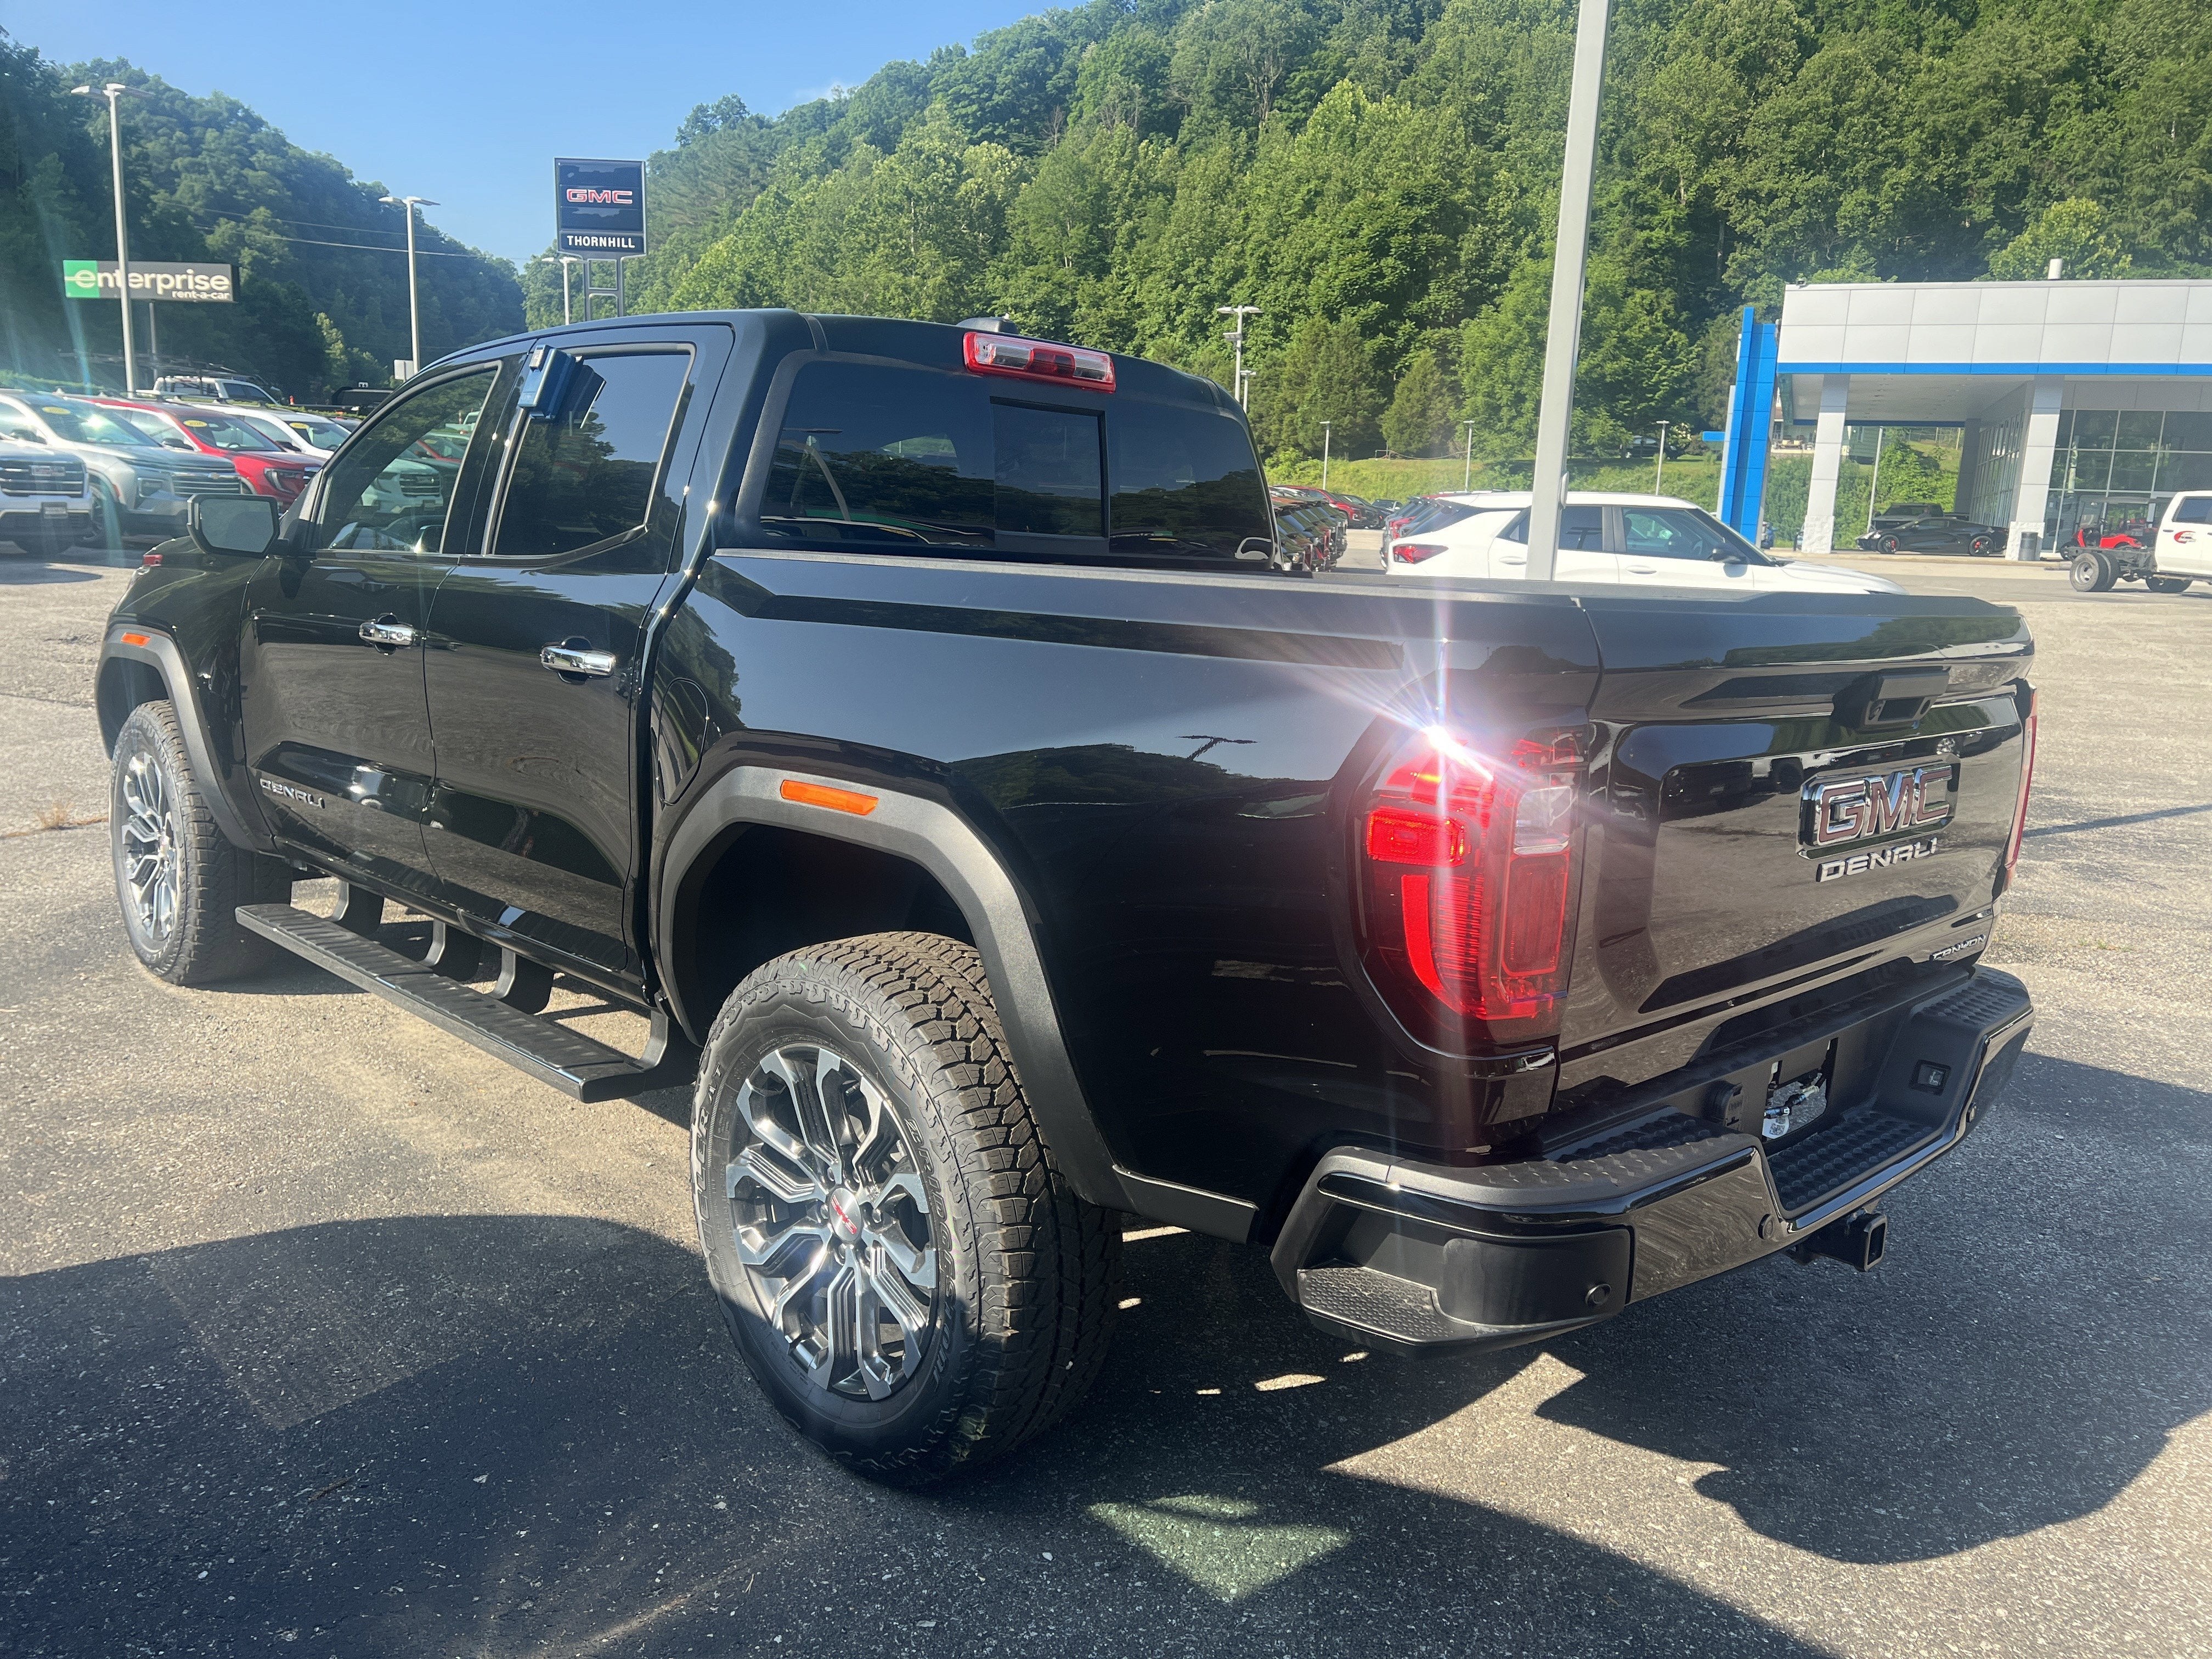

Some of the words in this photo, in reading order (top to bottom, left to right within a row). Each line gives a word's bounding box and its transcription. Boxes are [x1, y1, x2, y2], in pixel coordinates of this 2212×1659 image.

[566, 188, 633, 204] GMC
[566, 235, 635, 248] THORNHILL
[171, 290, 230, 299] rent-a-car
[259, 778, 325, 809] DENALI
[1814, 765, 1953, 845] GMC
[1816, 837, 1938, 882] DENALI
